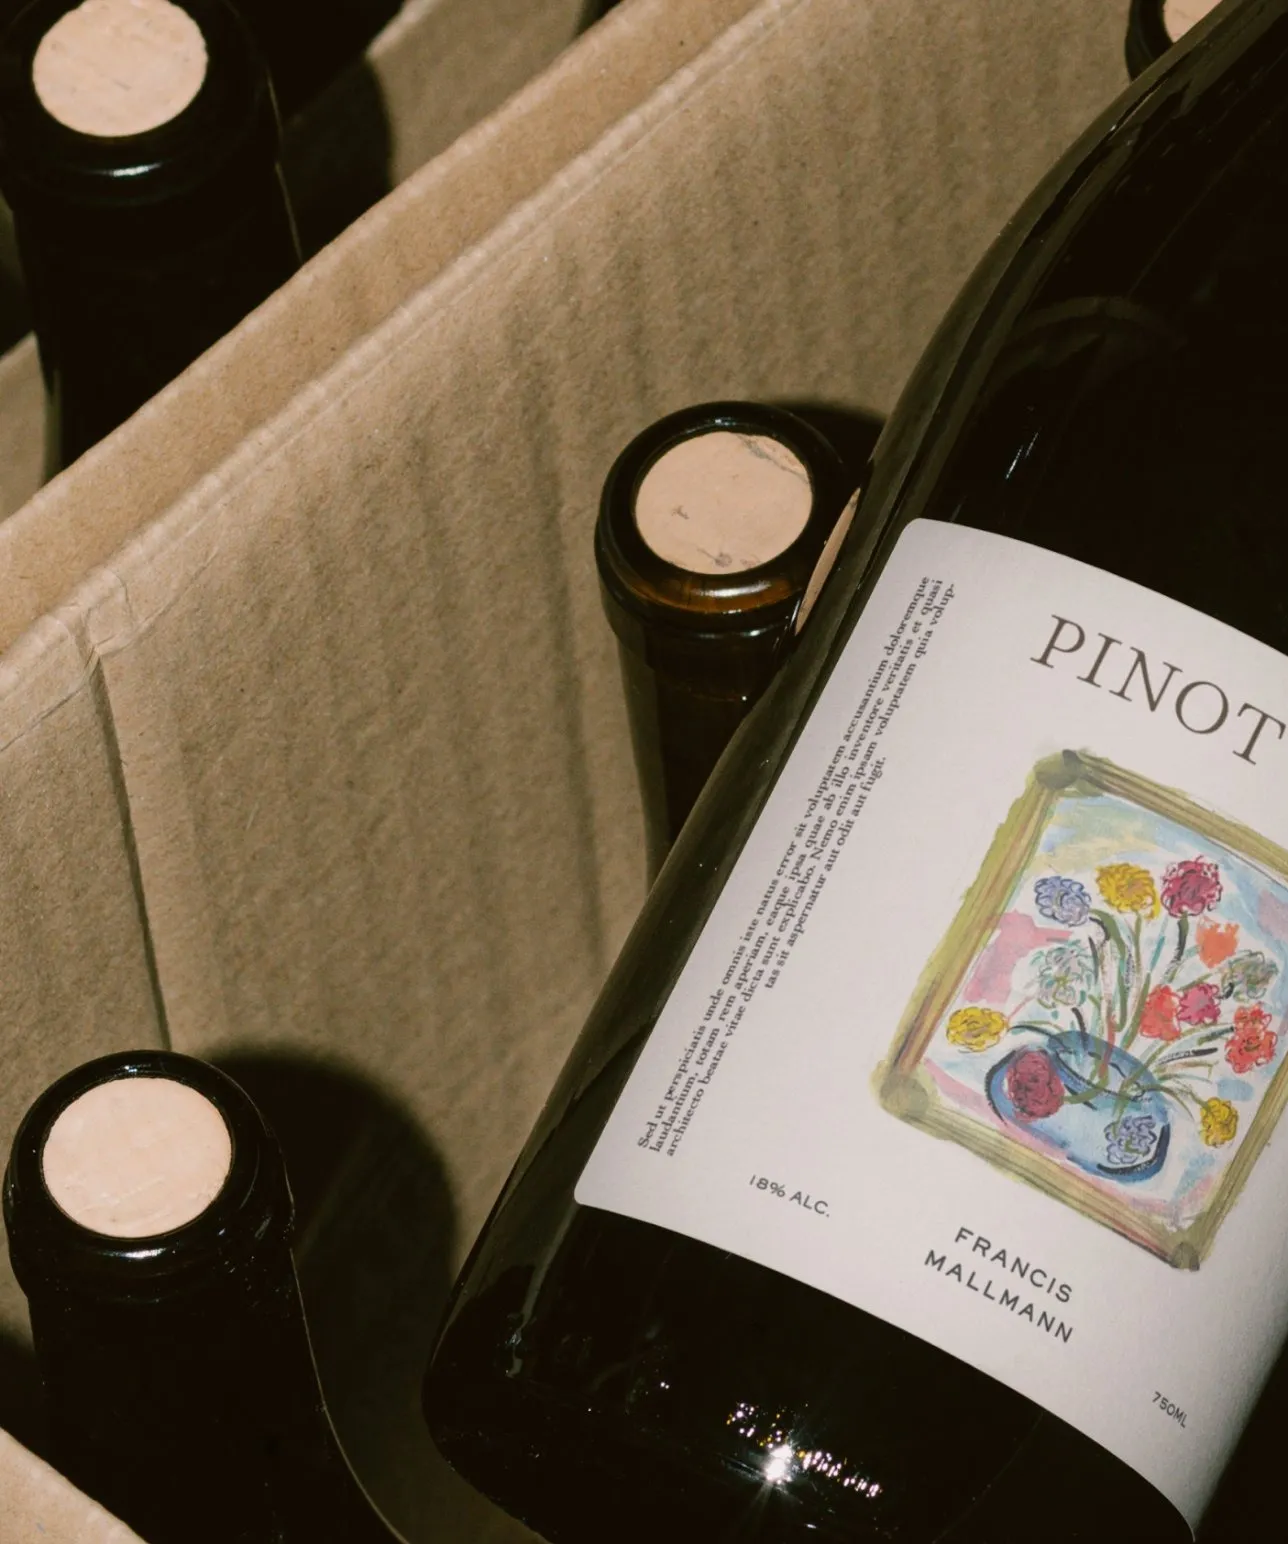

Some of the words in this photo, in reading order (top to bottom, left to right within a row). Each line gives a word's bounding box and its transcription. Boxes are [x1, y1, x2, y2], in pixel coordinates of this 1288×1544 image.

[1030, 615, 1286, 765] PINOT
[637, 1121, 658, 1147] Sed
[654, 1104, 666, 1118] ut
[663, 1025, 706, 1101] perspiciatis
[703, 988, 724, 1021] unde
[721, 945, 746, 985] omnis
[739, 918, 758, 941] iste
[755, 879, 778, 915] natus
[776, 840, 796, 876] error
[794, 823, 807, 837] sit
[803, 745, 846, 818] voluptatem
[843, 659, 888, 742] accusantium
[883, 576, 929, 656] doloremque
[666, 1088, 704, 1156] architecto
[696, 1041, 727, 1084] beatae
[724, 1005, 745, 1036] vitae
[740, 969, 764, 1002] dicta
[761, 936, 780, 965] sunt
[809, 819, 838, 860] Nemo
[835, 783, 856, 816] enim
[849, 741, 877, 779] ipsam
[874, 662, 916, 735] voluptatem
[914, 630, 933, 658] quia
[695, 1027, 720, 1065] totam
[718, 995, 736, 1021] rem
[766, 886, 790, 926] eaque
[784, 853, 806, 880] ipsa
[804, 815, 825, 848] quae
[822, 793, 836, 810] ab
[830, 766, 849, 787] illo
[843, 697, 883, 760] inventore
[881, 638, 913, 691] veritatis
[911, 620, 922, 633] et
[920, 579, 942, 615] quasi
[764, 969, 780, 988] tas
[775, 949, 789, 966] sit
[786, 873, 826, 947] aspernatur
[823, 848, 840, 871] aut
[836, 818, 854, 846] odit
[851, 794, 867, 816] aut
[750, 1175, 785, 1197] 18%
[789, 1191, 829, 1217] ALC.
[955, 1227, 1072, 1302] FRANCIS
[925, 1250, 1073, 1343] MALLMANN
[1153, 1391, 1187, 1428] 750ML
